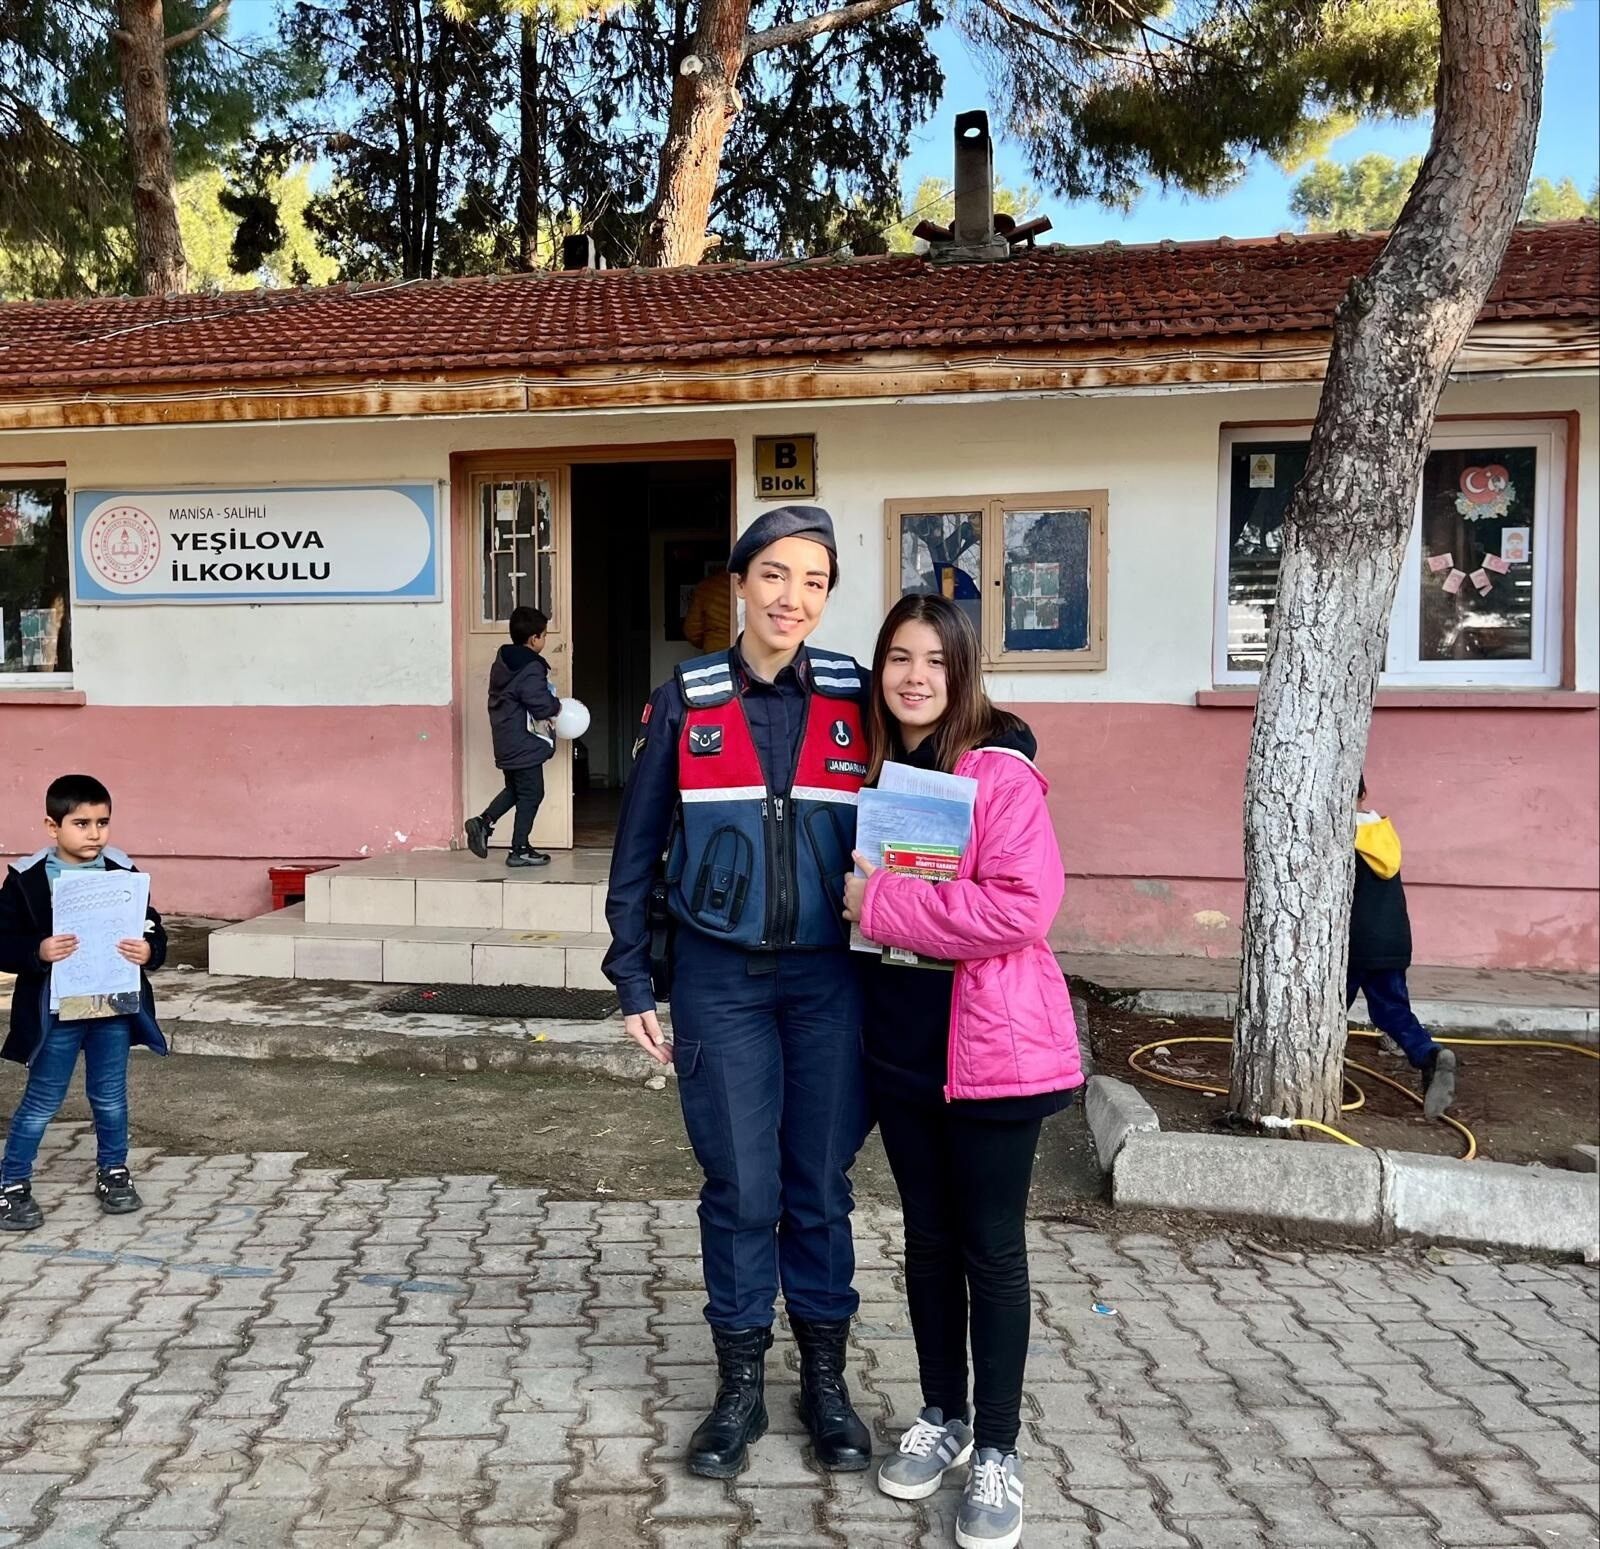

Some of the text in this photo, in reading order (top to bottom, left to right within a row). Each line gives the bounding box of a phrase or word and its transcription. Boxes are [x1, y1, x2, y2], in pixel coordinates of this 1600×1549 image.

[775, 442, 798, 469] B
[761, 475, 806, 491] Blok
[169, 505, 214, 520] MANİSA
[223, 504, 266, 519] SALİHLİ
[170, 528, 324, 555] YEŞİLOVA
[171, 560, 331, 582] İLKOKULU
